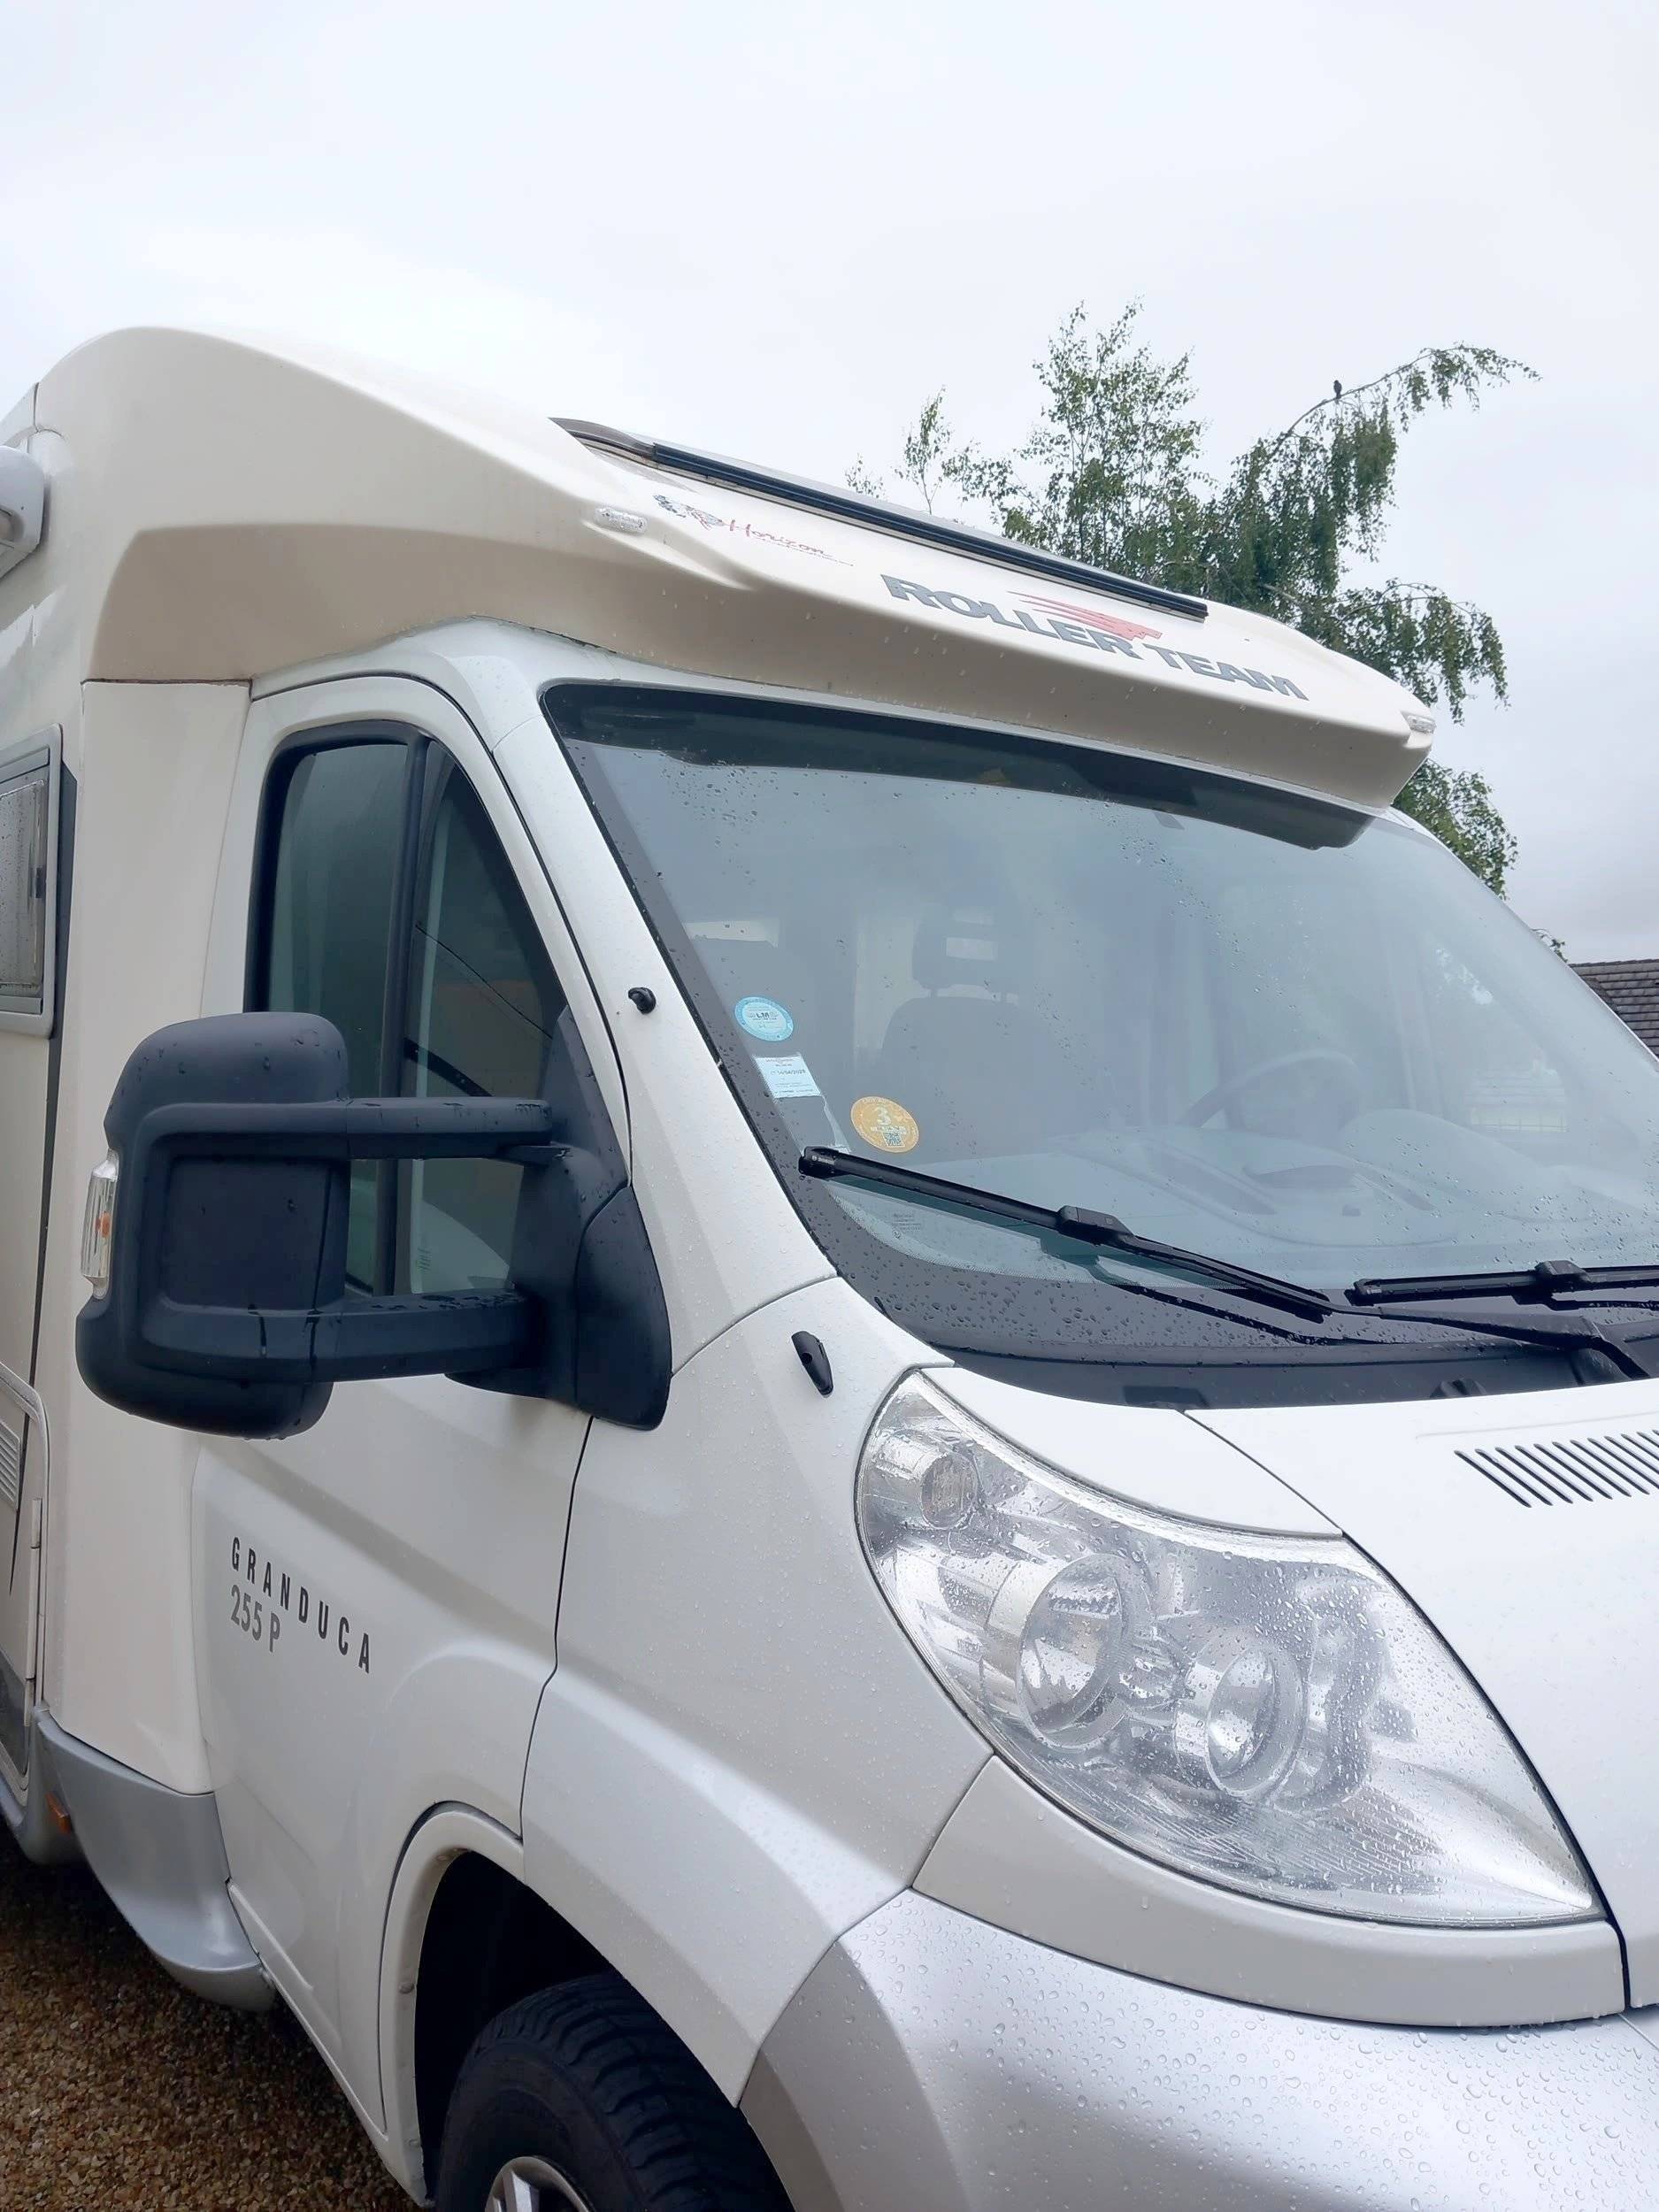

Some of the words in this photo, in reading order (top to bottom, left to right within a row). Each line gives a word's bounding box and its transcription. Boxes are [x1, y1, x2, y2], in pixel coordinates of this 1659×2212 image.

[729, 518, 833, 557] Horizon
[879, 573, 1144, 660] ROLLER
[1143, 642, 1310, 702] TEAM
[230, 1584, 263, 1641] 255
[268, 1612, 280, 1653] P
[231, 1536, 370, 1674] GRANDUCA
